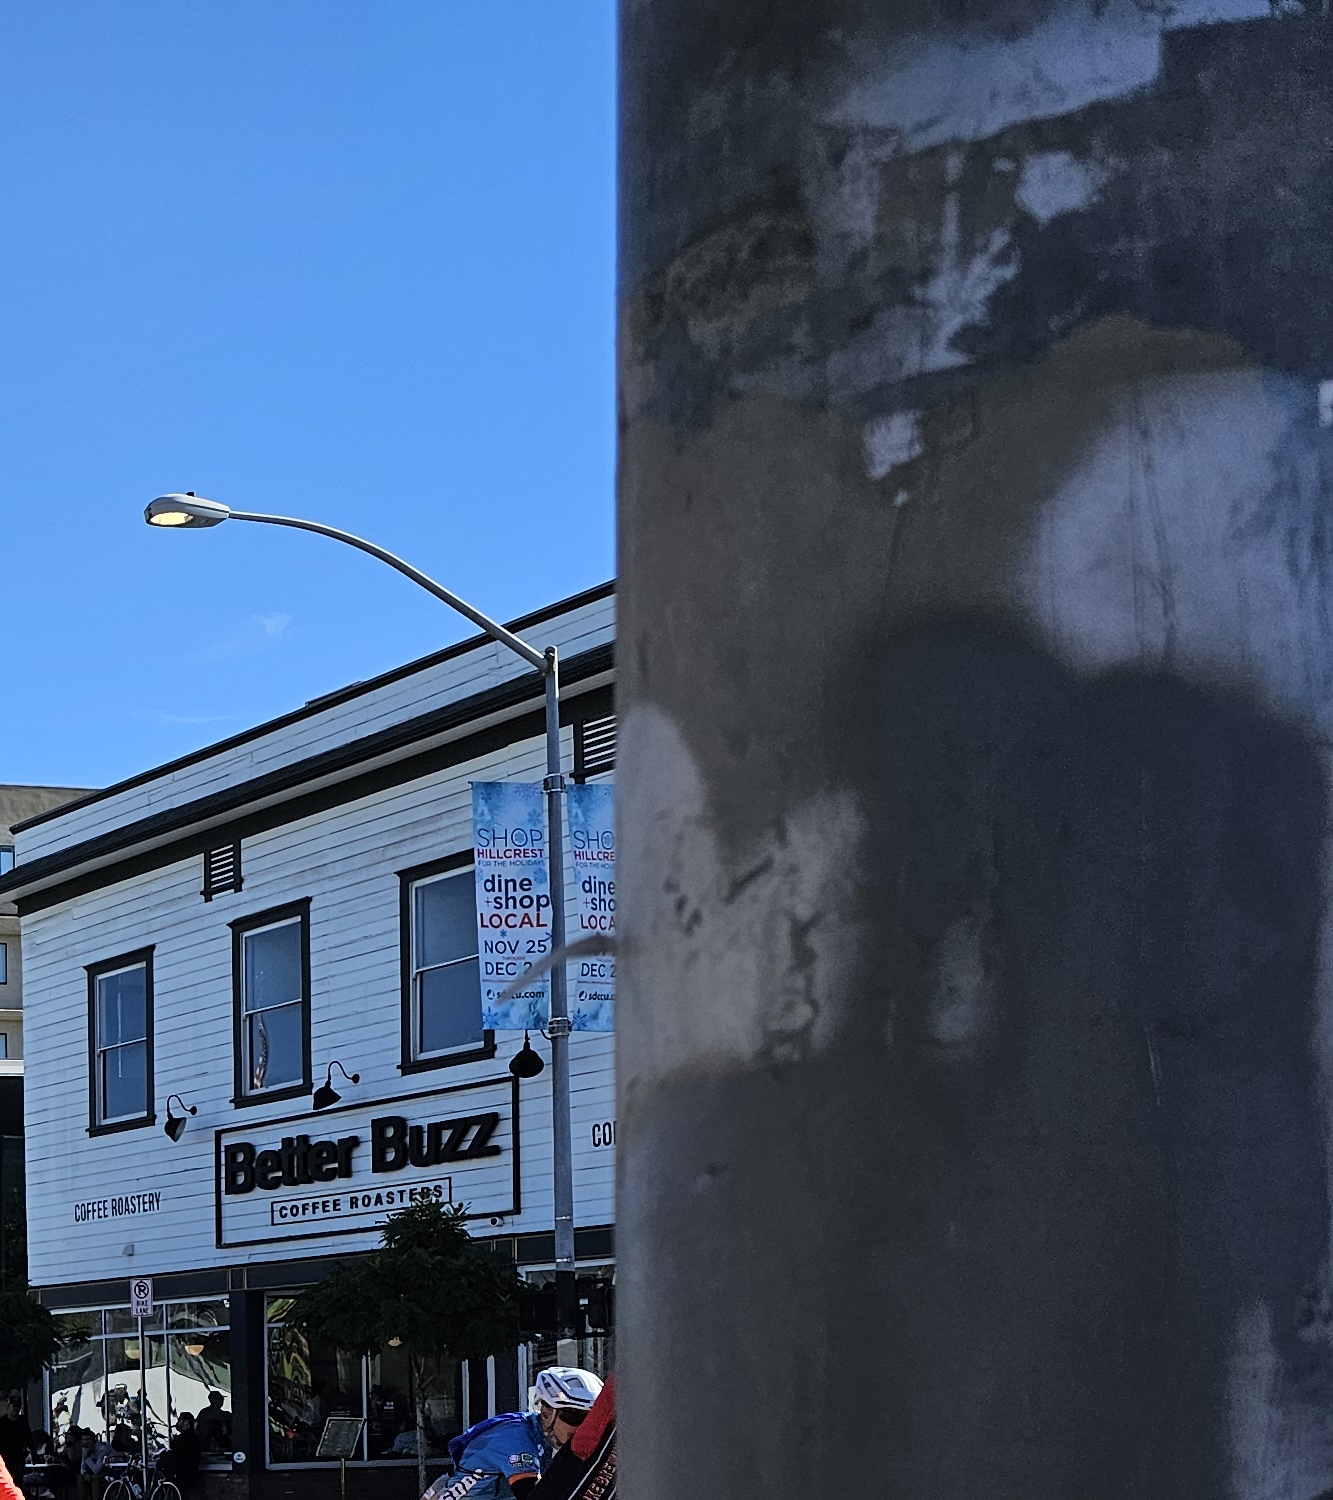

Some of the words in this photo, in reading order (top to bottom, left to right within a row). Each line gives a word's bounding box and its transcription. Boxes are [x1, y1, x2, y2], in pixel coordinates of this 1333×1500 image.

[477, 827, 543, 848] SHOP
[573, 830, 615, 851] SHO
[477, 848, 544, 860] HILLCREST
[574, 850, 616, 862] HILLCRE
[509, 859, 546, 867] HOLIDAYS
[484, 874, 533, 893] dine
[584, 896, 616, 912] +sho
[479, 912, 548, 929] LOCAL
[580, 914, 616, 931] LOCA
[484, 940, 520, 954] NOV
[525, 939, 547, 954] 25
[485, 962, 517, 976] DEC
[581, 962, 606, 978] DEC
[224, 1133, 361, 1196] Better
[370, 1111, 502, 1174] Buzz
[74, 1200, 109, 1223] COFFEE
[111, 1191, 161, 1218] ROASTERY
[278, 1199, 342, 1219] COFFEE
